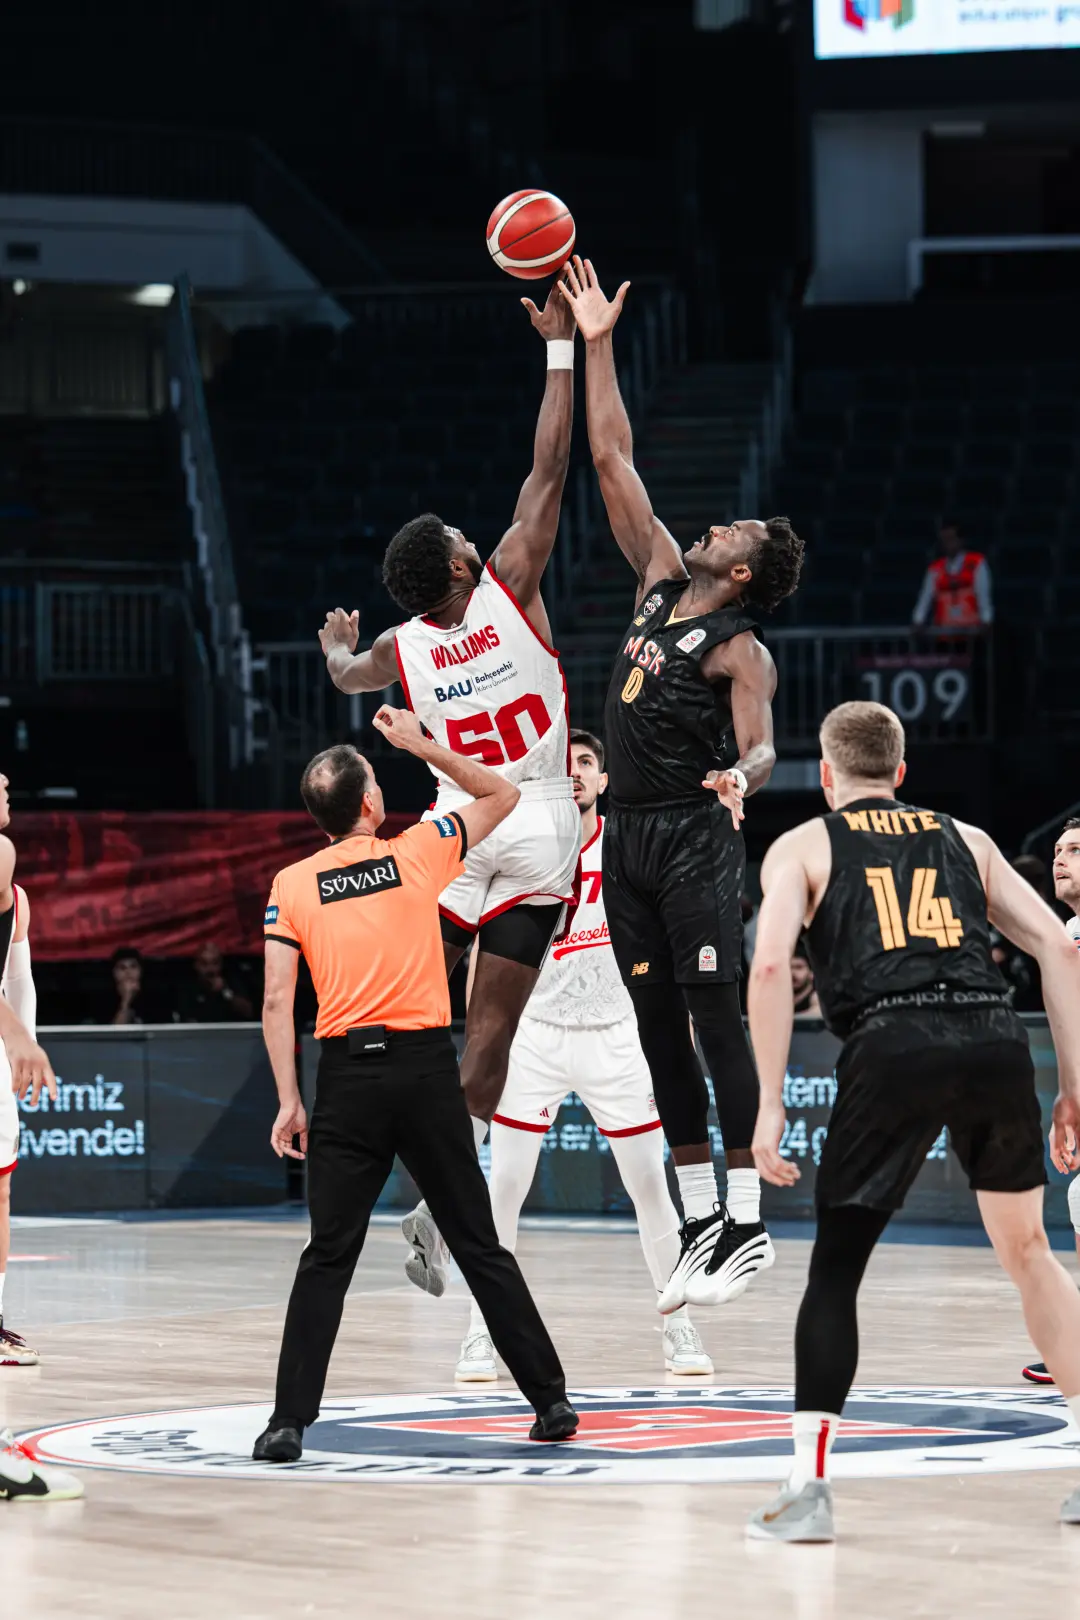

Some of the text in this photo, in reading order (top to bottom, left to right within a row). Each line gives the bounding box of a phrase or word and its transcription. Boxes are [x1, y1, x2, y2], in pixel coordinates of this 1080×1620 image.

[430, 624, 500, 670] WILLIAMS
[623, 636, 666, 675] MSK
[434, 680, 473, 703] BAU
[621, 666, 645, 704] 0
[861, 671, 967, 721] 109
[445, 693, 552, 766] 50
[842, 809, 942, 834] WHITE
[865, 866, 964, 951] 14
